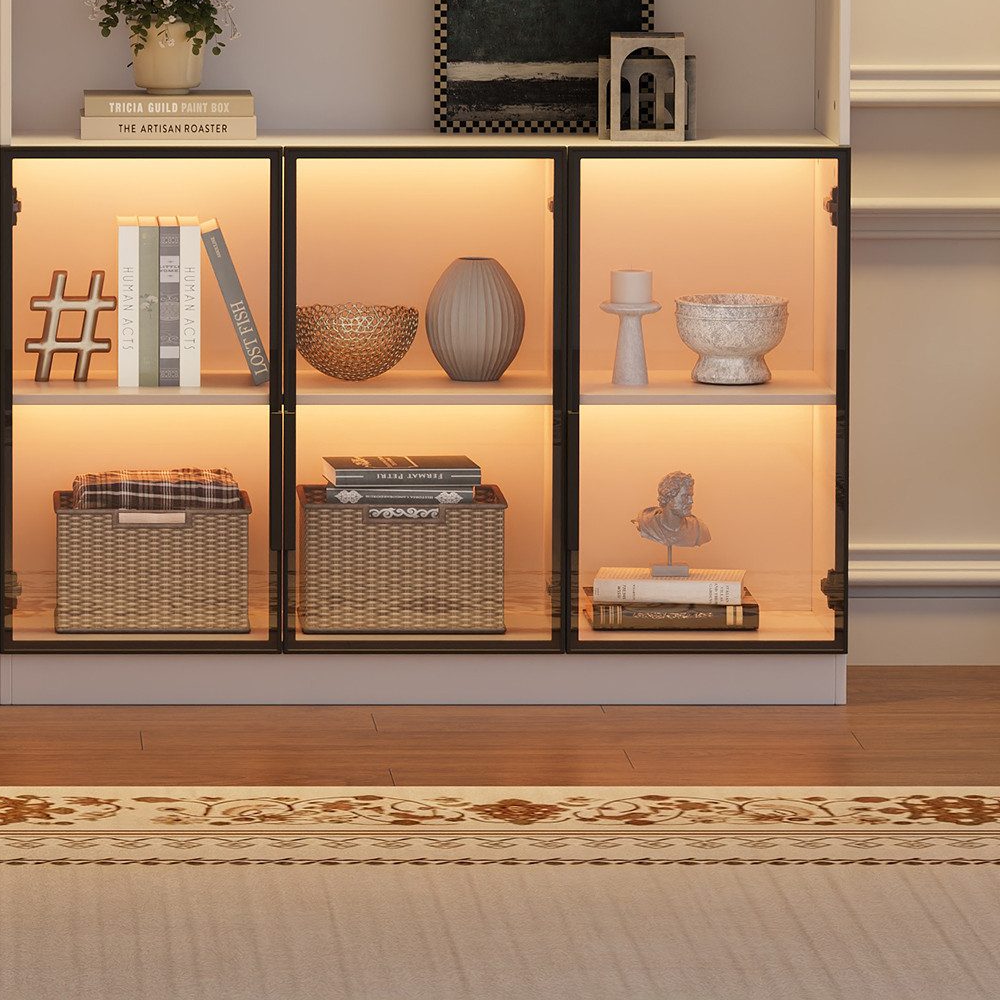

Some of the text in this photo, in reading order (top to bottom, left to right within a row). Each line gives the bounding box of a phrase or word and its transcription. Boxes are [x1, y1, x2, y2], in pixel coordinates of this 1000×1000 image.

[109, 102, 230, 113] TRICIA GUILD PAINT BOX
[118, 124, 228, 133] THE ARTISAN ROASTER
[122, 267, 134, 350] HUMAN ACTS
[184, 267, 195, 350] HUMAN ACTS
[230, 300, 269, 375] LOST FISH
